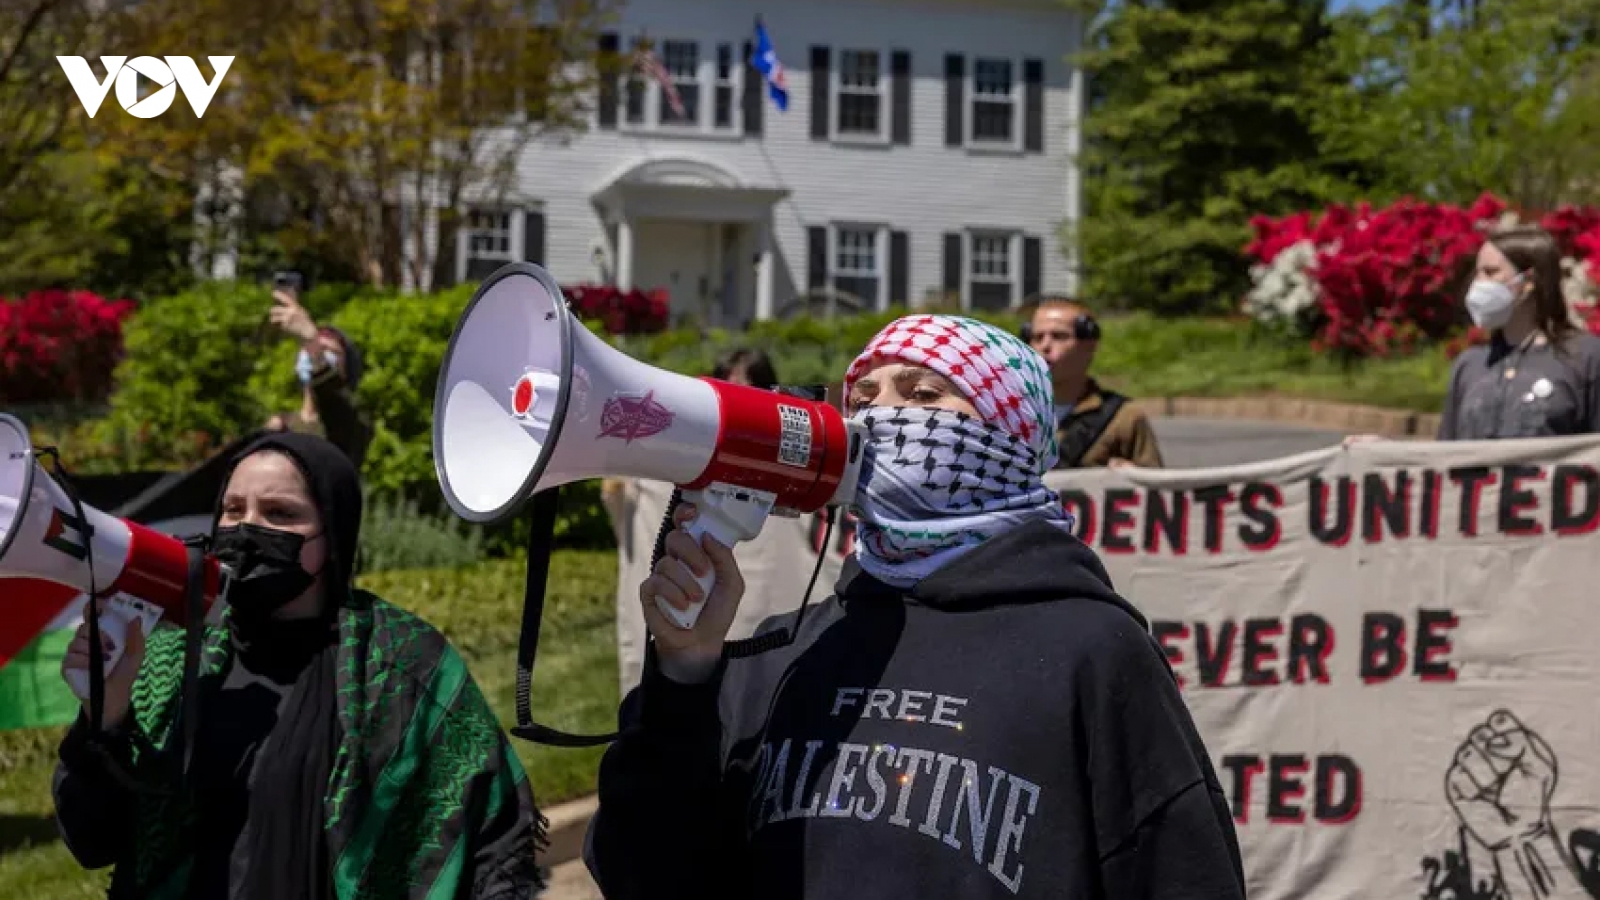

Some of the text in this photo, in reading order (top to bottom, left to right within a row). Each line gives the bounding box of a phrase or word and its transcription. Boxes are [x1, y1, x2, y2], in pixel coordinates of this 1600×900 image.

[1307, 464, 1600, 547] UNITED
[1358, 608, 1459, 686] BE
[829, 686, 968, 730] FREE
[1222, 754, 1363, 824] TED
